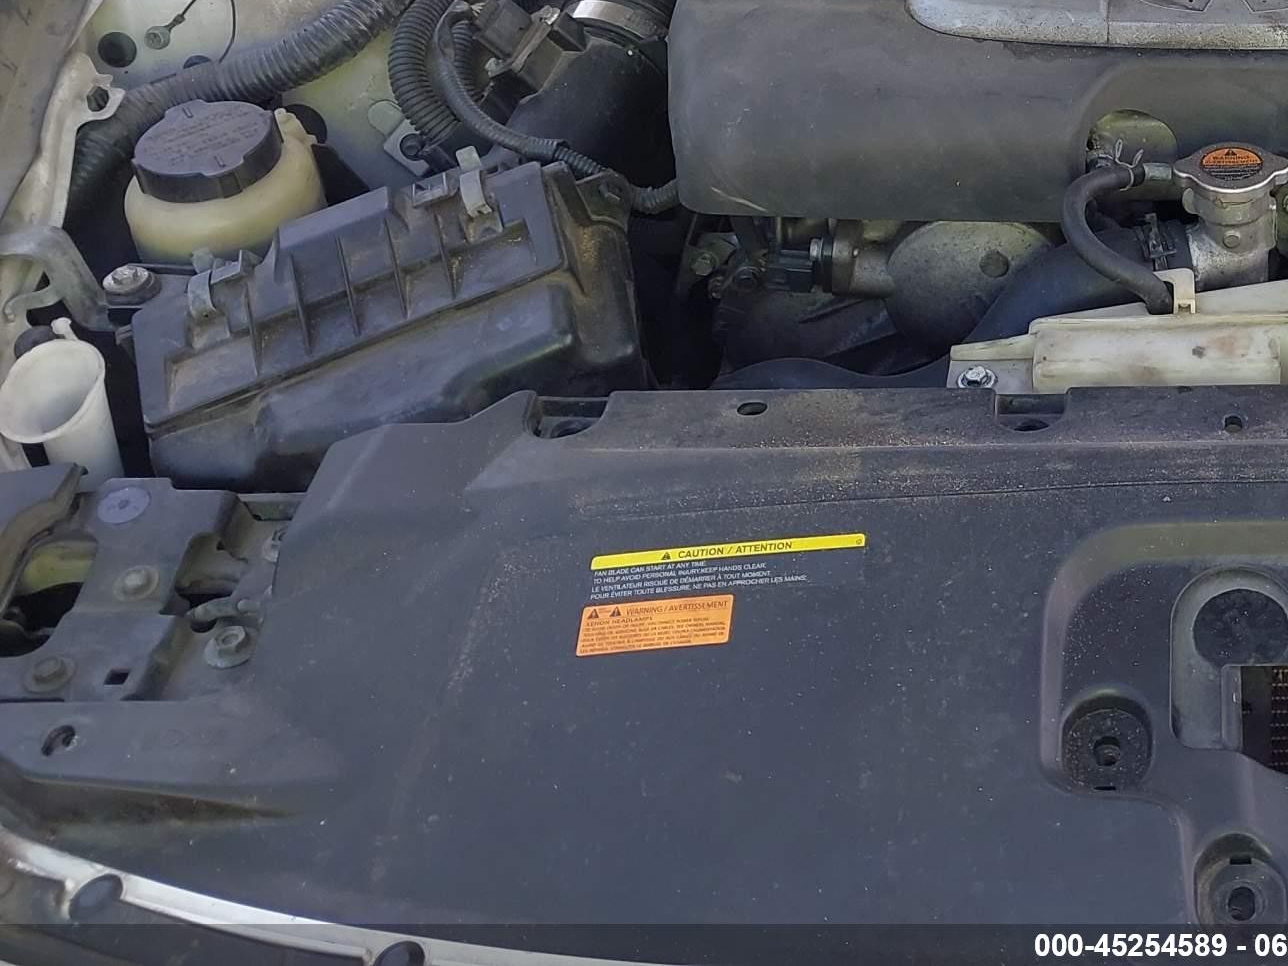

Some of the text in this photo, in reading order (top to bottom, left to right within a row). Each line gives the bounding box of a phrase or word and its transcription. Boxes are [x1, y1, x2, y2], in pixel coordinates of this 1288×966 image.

[678, 541, 792, 559] CAUTION / ATTENTION
[608, 568, 629, 576] BLADE
[646, 564, 665, 572] START
[676, 561, 690, 569] ANY
[642, 571, 677, 579] PERSONAL
[719, 564, 742, 572] HANDS
[590, 592, 609, 600] POUR
[610, 590, 632, 598] ÉVITER
[634, 587, 655, 595] TOUTE
[703, 581, 716, 589] PAS
[727, 577, 769, 586] APPROCHER
[601, 581, 642, 592] VENTILATEUR
[643, 579, 668, 587] RISQUE
[680, 575, 716, 584] DÉMARRER
[723, 572, 740, 580] TOUT
[626, 605, 663, 616] WARNING
[612, 616, 653, 624] HEADLAMPS
